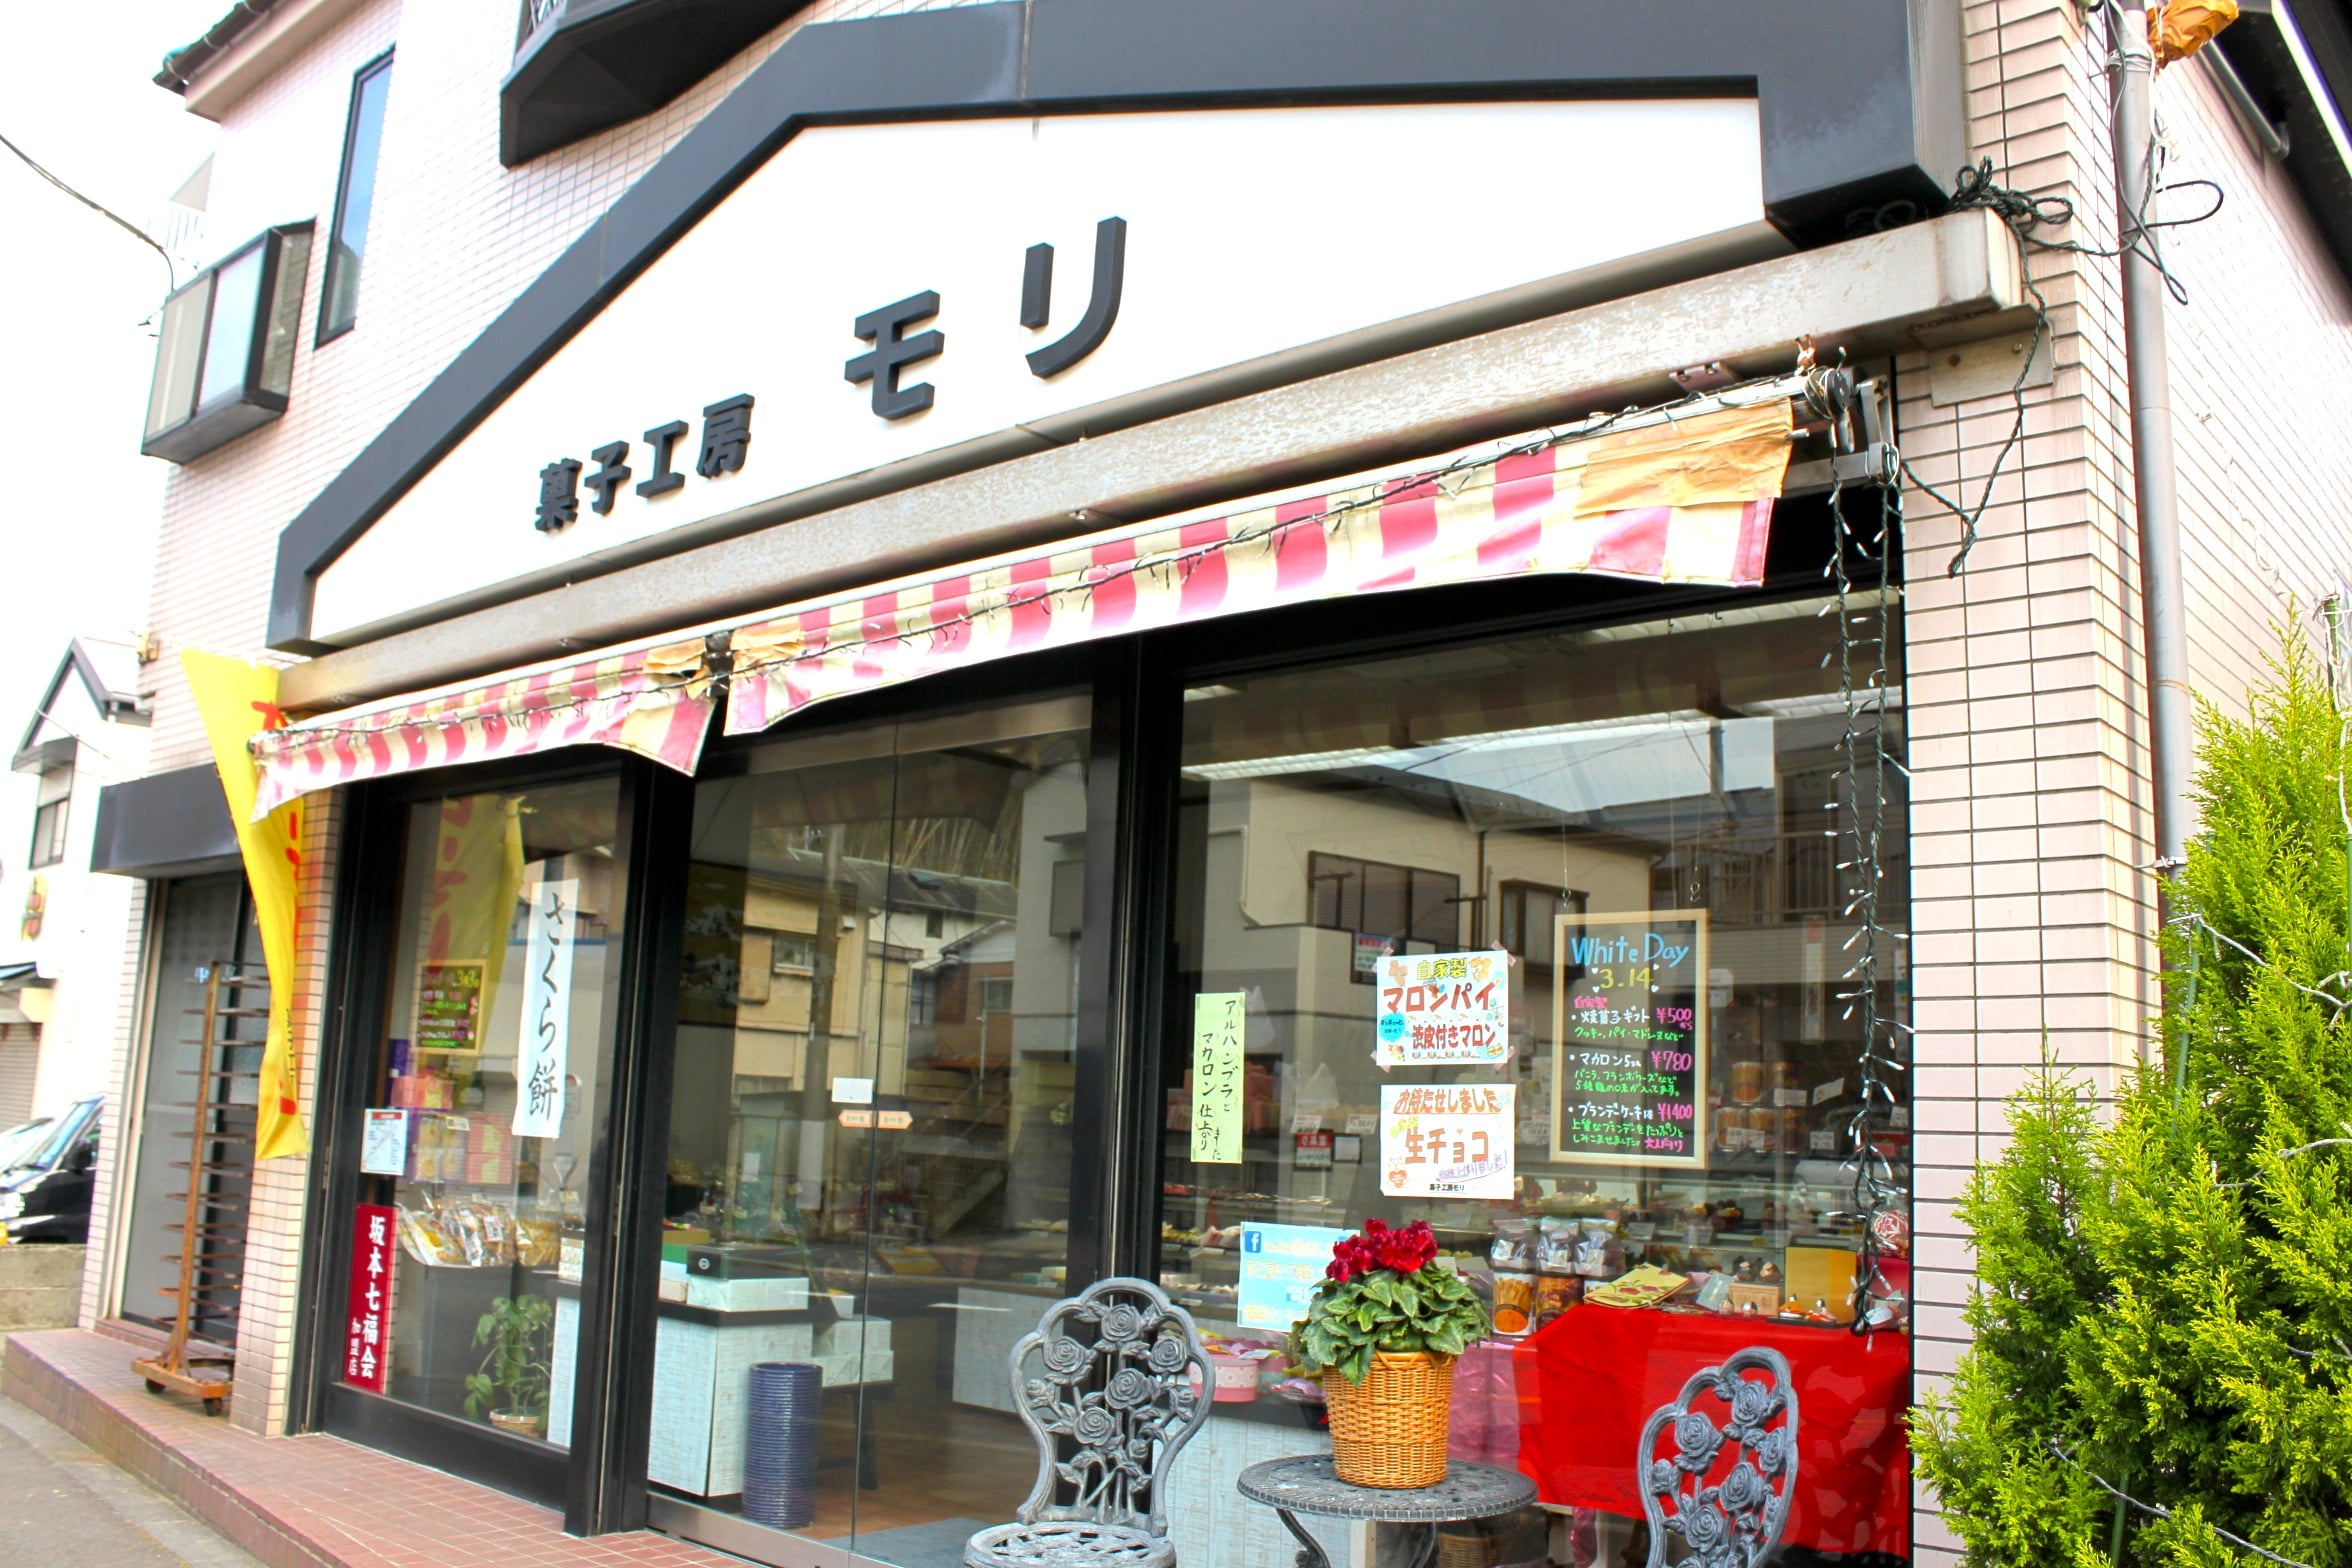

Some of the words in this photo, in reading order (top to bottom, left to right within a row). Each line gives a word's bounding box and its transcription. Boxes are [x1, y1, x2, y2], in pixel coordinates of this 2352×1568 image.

[535, 392, 755, 533] 菓子工房
[844, 216, 1127, 420] モリ
[1571, 936, 1639, 966] White
[1644, 932, 1690, 968] Day
[1417, 957, 1467, 980] 自家製
[1600, 967, 1653, 990] 3.14
[528, 893, 559, 1121] さくら餅
[1384, 982, 1496, 1013] マロンパイ
[1656, 1007, 1692, 1024] ¥500
[1412, 1024, 1496, 1050] 渋皮付きマロン
[1220, 1000, 1239, 1112] アルハンブラと
[1651, 1050, 1692, 1071] ¥780
[1393, 1088, 1502, 1114] お待たせしました
[1657, 1103, 1693, 1121] ¥1400
[1405, 1127, 1489, 1164] 生チョコ
[360, 1215, 386, 1379] 坂本七福会
